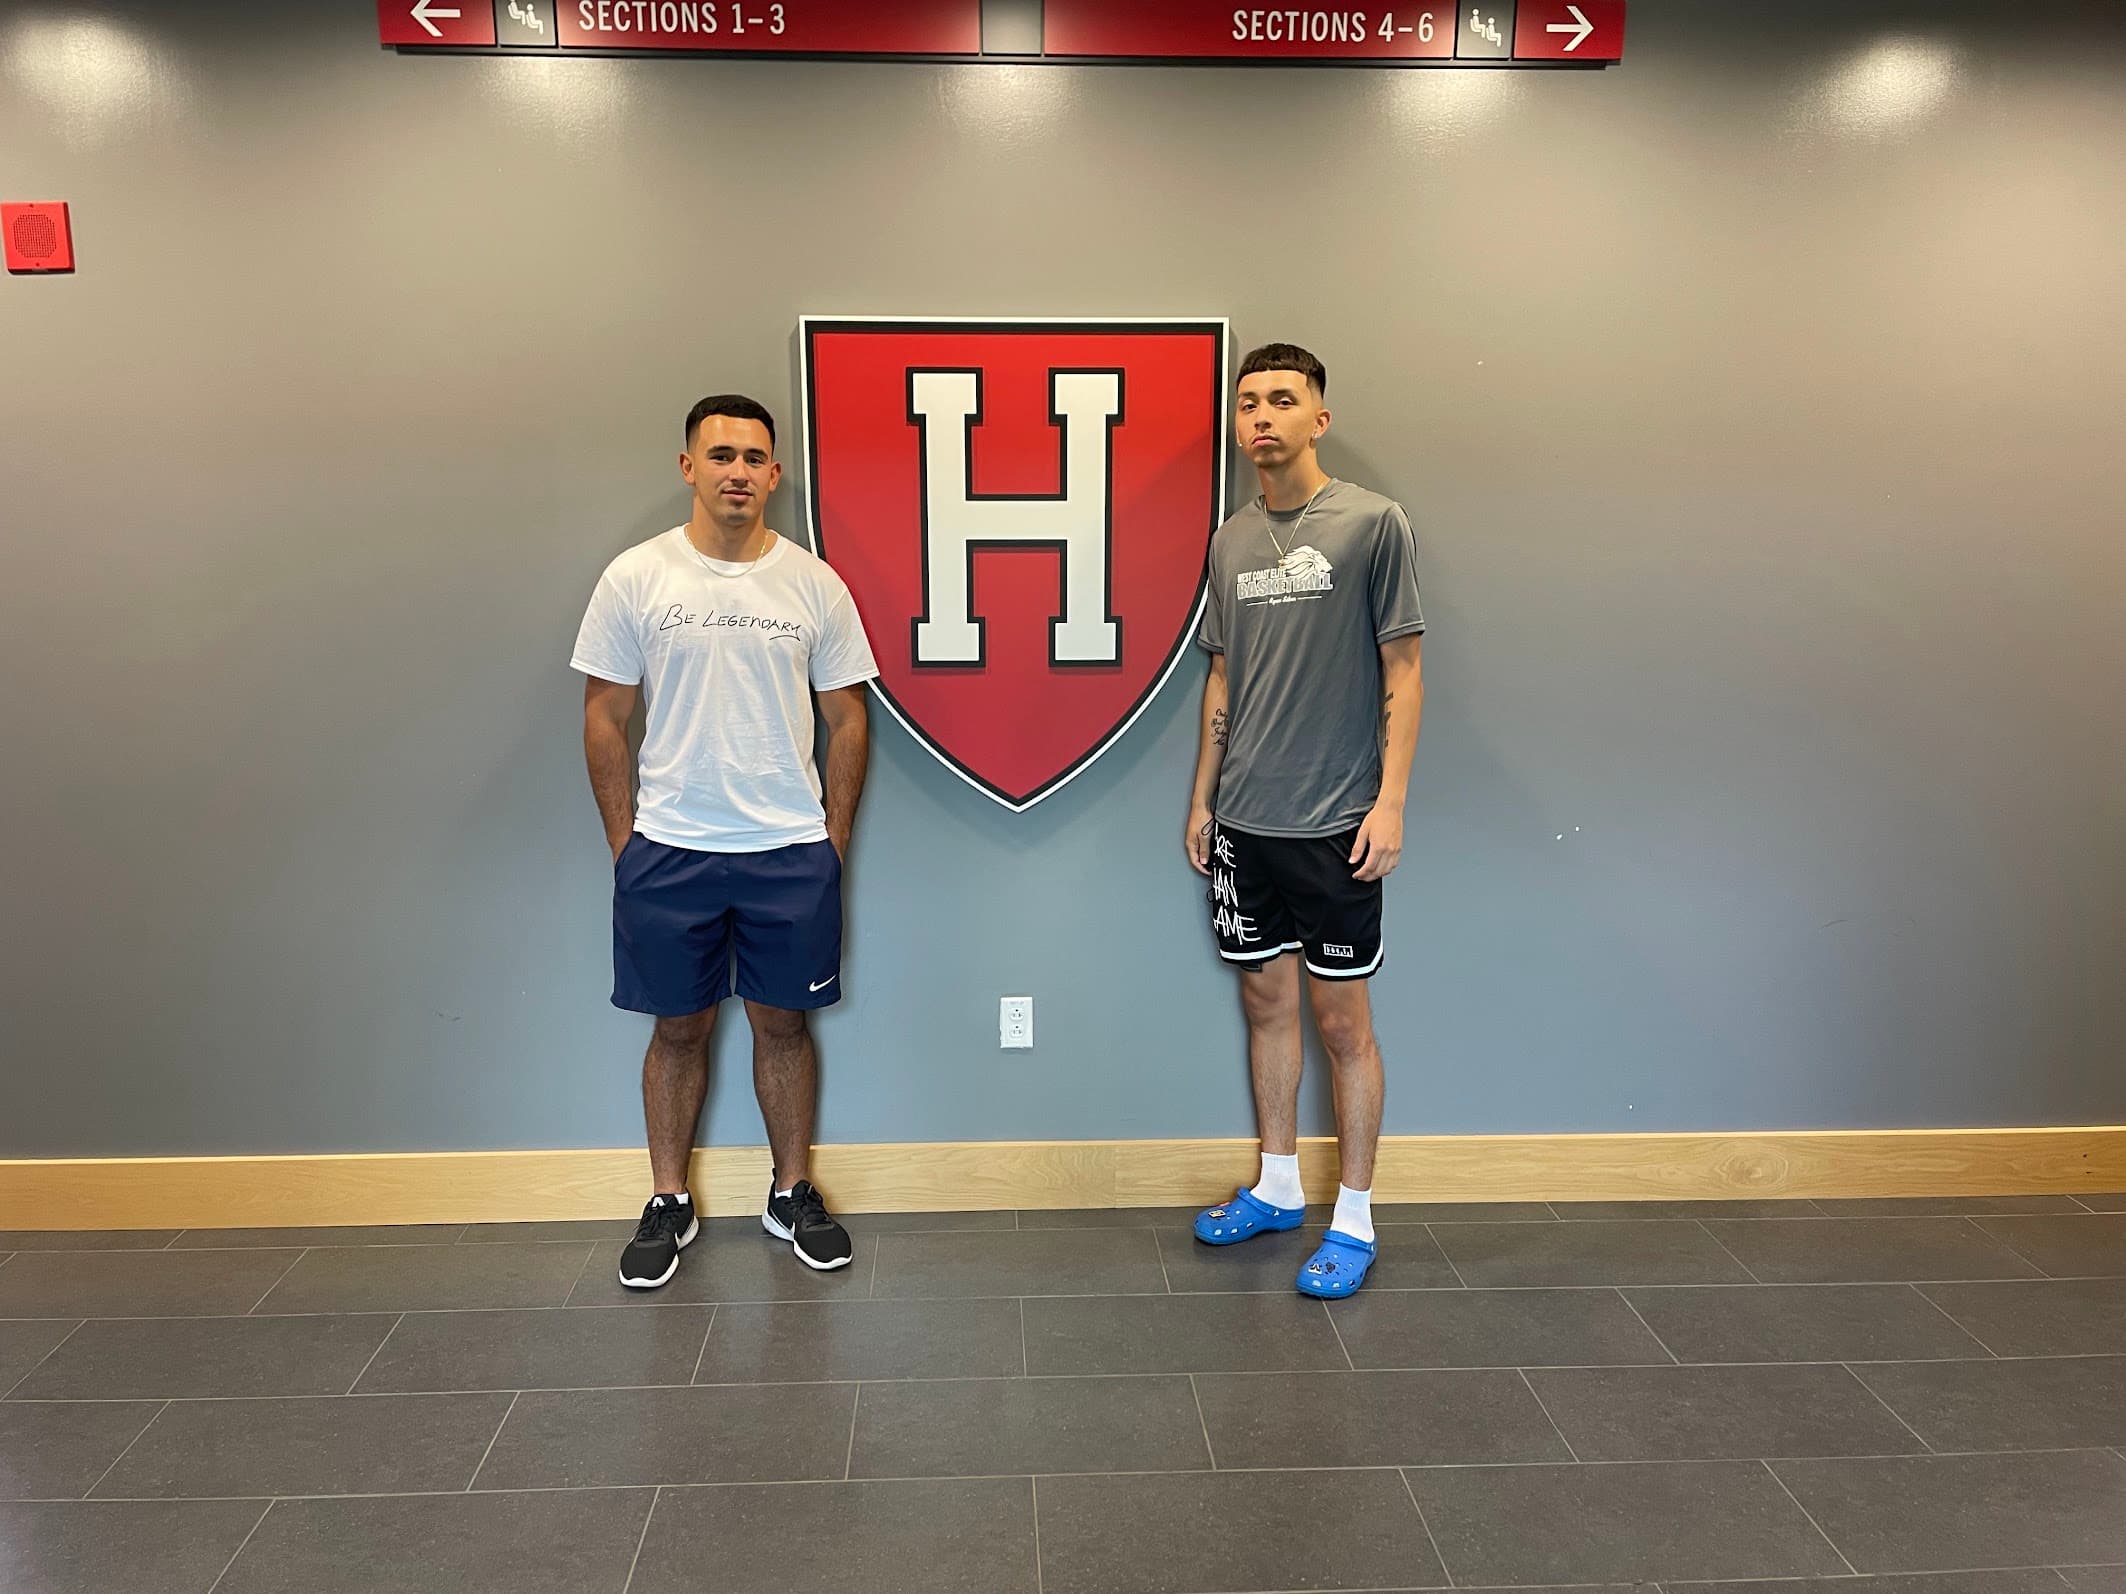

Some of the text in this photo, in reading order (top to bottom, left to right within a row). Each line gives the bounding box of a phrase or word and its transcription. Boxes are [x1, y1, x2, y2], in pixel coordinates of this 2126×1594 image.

[578, 0, 718, 34] SECTIONS
[1232, 10, 1367, 42] SECTIONS
[907, 368, 1124, 666] H
[1236, 573, 1334, 600] BASKETBALL
[1213, 905, 1262, 946] AME
